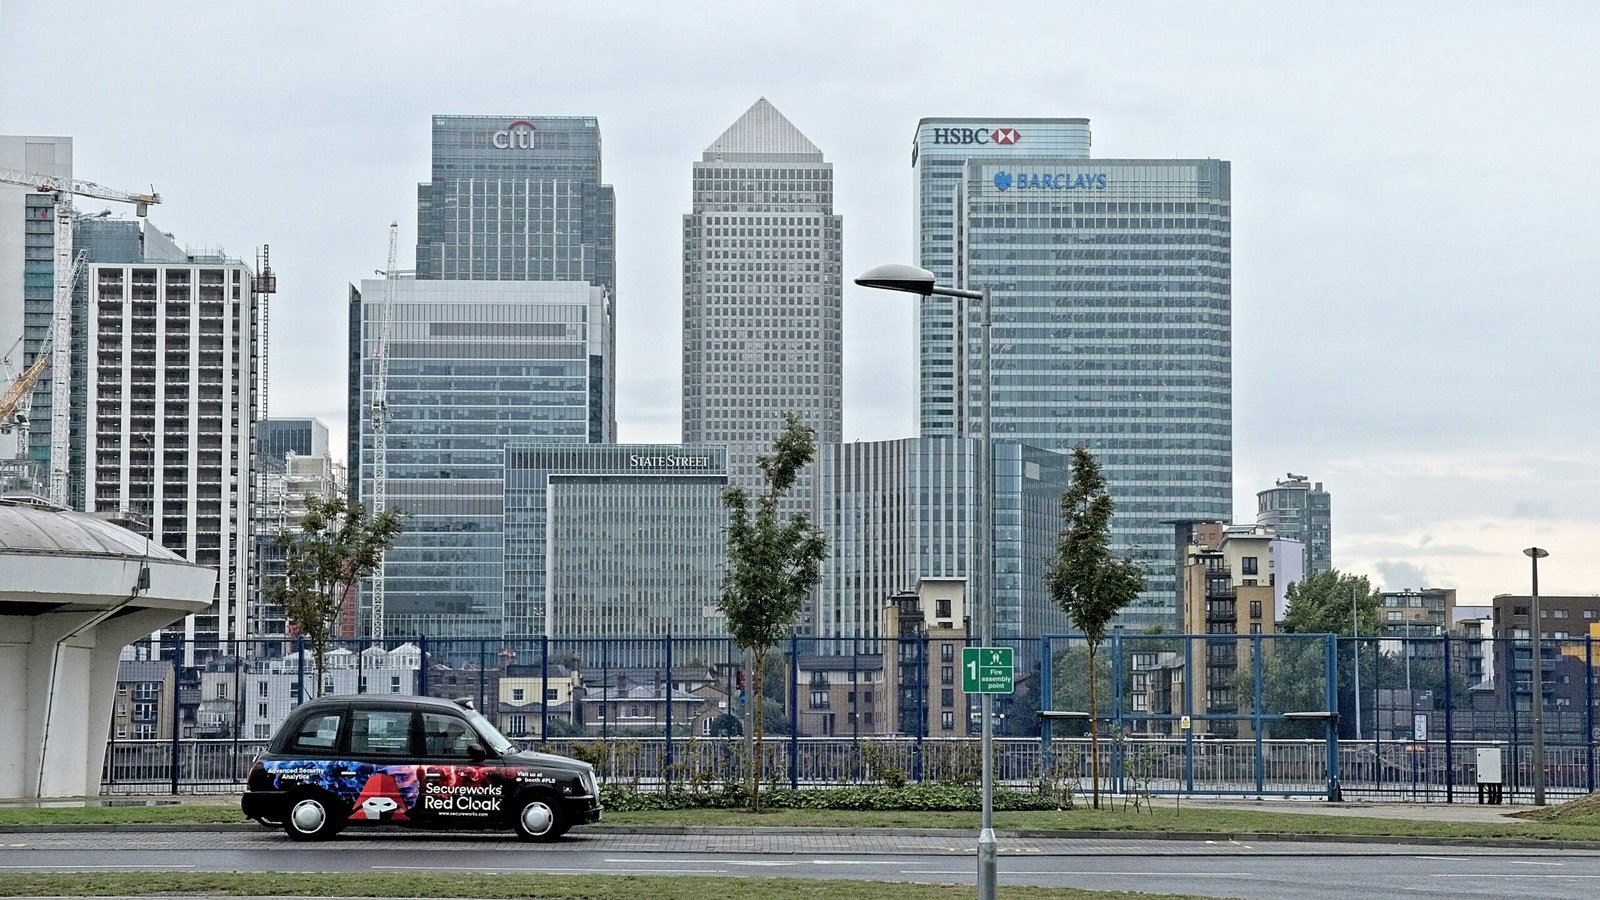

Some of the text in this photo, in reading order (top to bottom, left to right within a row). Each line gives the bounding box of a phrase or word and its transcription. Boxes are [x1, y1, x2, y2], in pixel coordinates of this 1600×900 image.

[492, 126, 535, 149] citi
[933, 128, 989, 145] HSBC
[1016, 173, 1107, 190] BARCLAYS
[630, 454, 710, 467] STATE STREET
[967, 660, 976, 680] 1
[981, 676, 1012, 684] assembly
[281, 773, 310, 781] Analytics
[299, 767, 325, 775] Security
[425, 782, 502, 796] Secureworks
[424, 795, 501, 812] Red Cloak
